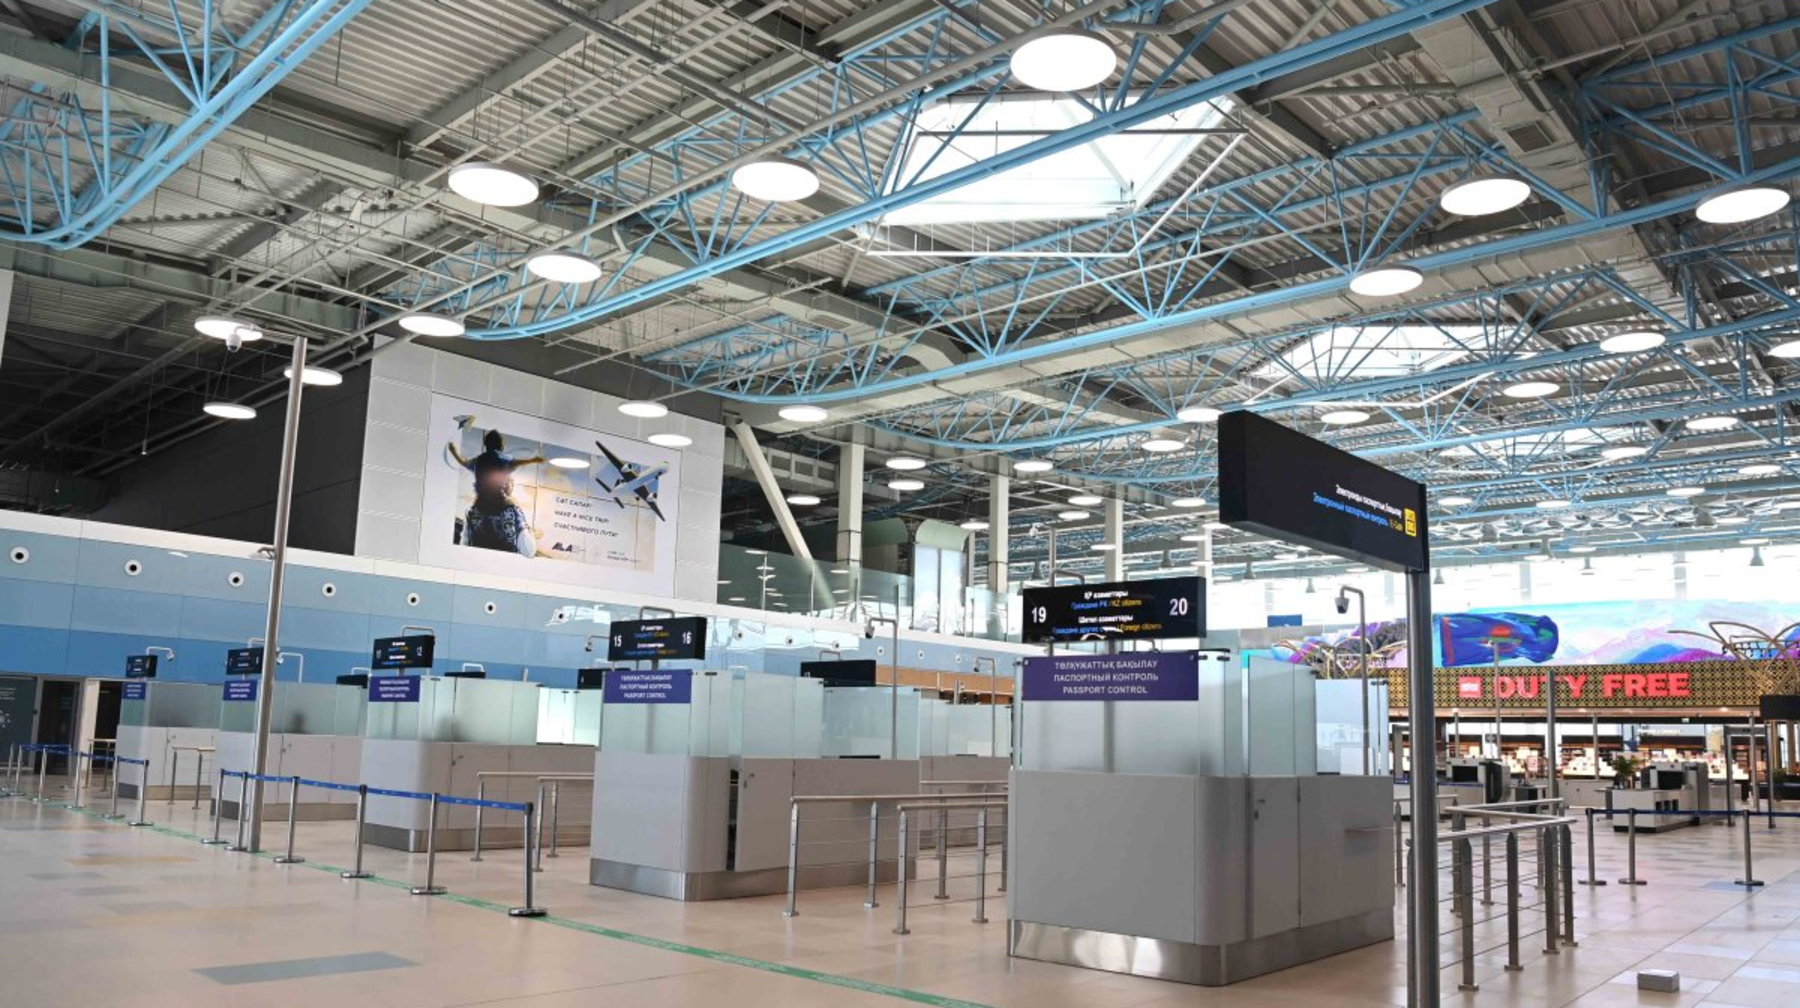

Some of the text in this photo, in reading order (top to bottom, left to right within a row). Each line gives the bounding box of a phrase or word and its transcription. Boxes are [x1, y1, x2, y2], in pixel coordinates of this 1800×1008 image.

[578, 514, 593, 522] NICE
[1169, 597, 1188, 616] 20
[1031, 606, 1047, 623] 19
[613, 634, 622, 647] 15
[682, 631, 692, 645] 16
[1054, 672, 1159, 682] ПАСПОРТНЫЙ КОНТРОЛЬ
[1063, 685, 1149, 694] PASSPORT CONTROL
[1603, 673, 1691, 698] FREE
